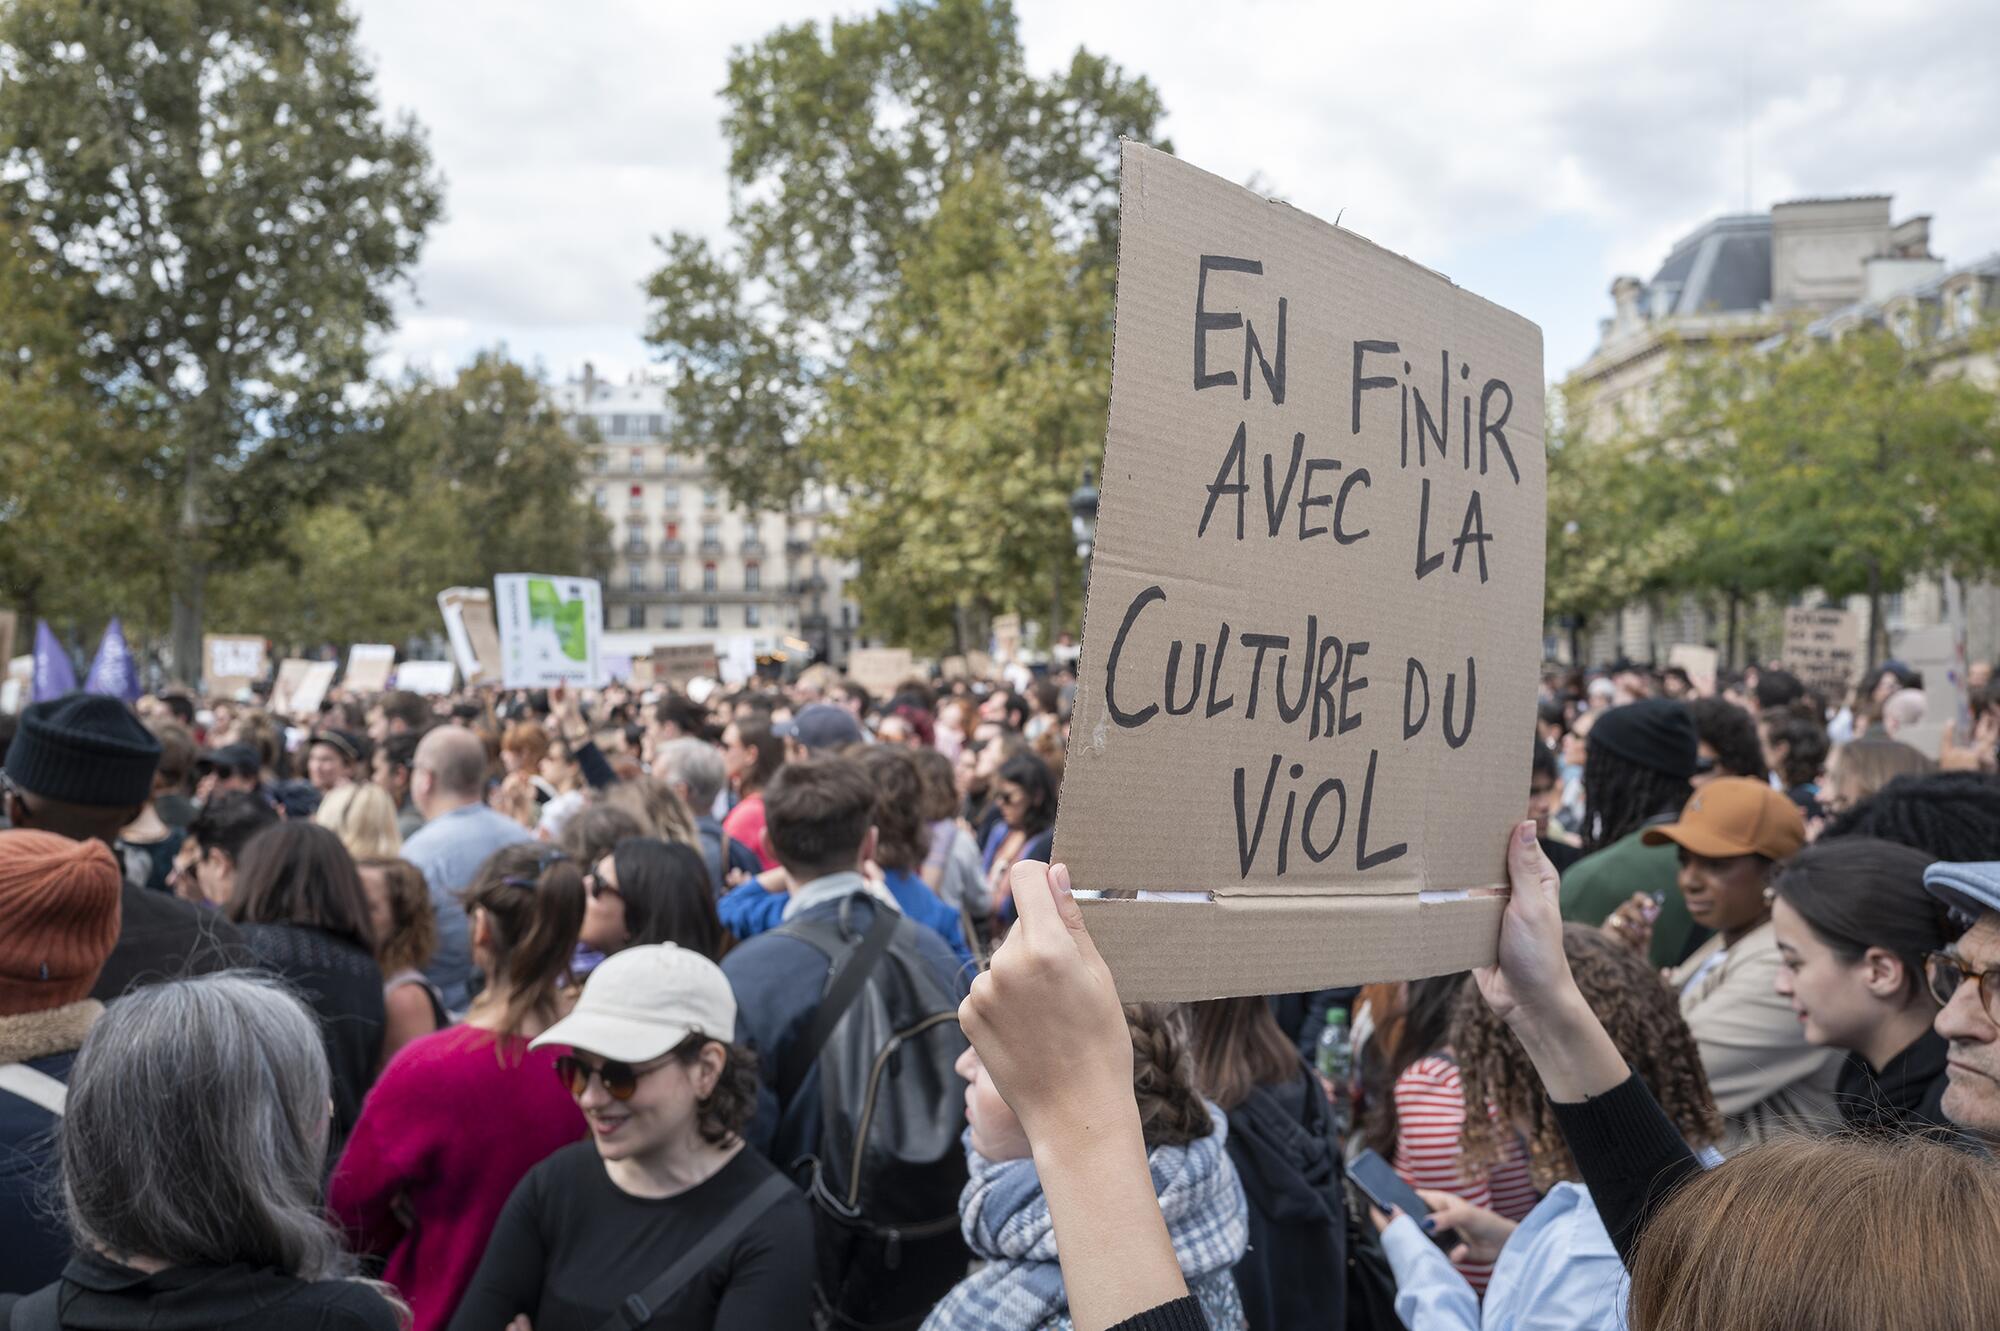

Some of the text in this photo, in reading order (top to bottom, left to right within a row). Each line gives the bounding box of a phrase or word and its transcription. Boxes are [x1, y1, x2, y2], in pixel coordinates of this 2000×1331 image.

[1193, 254, 1288, 406] EN
[1197, 420, 1494, 585] AVEC LA
[1105, 585, 1477, 750] CULTURE DU
